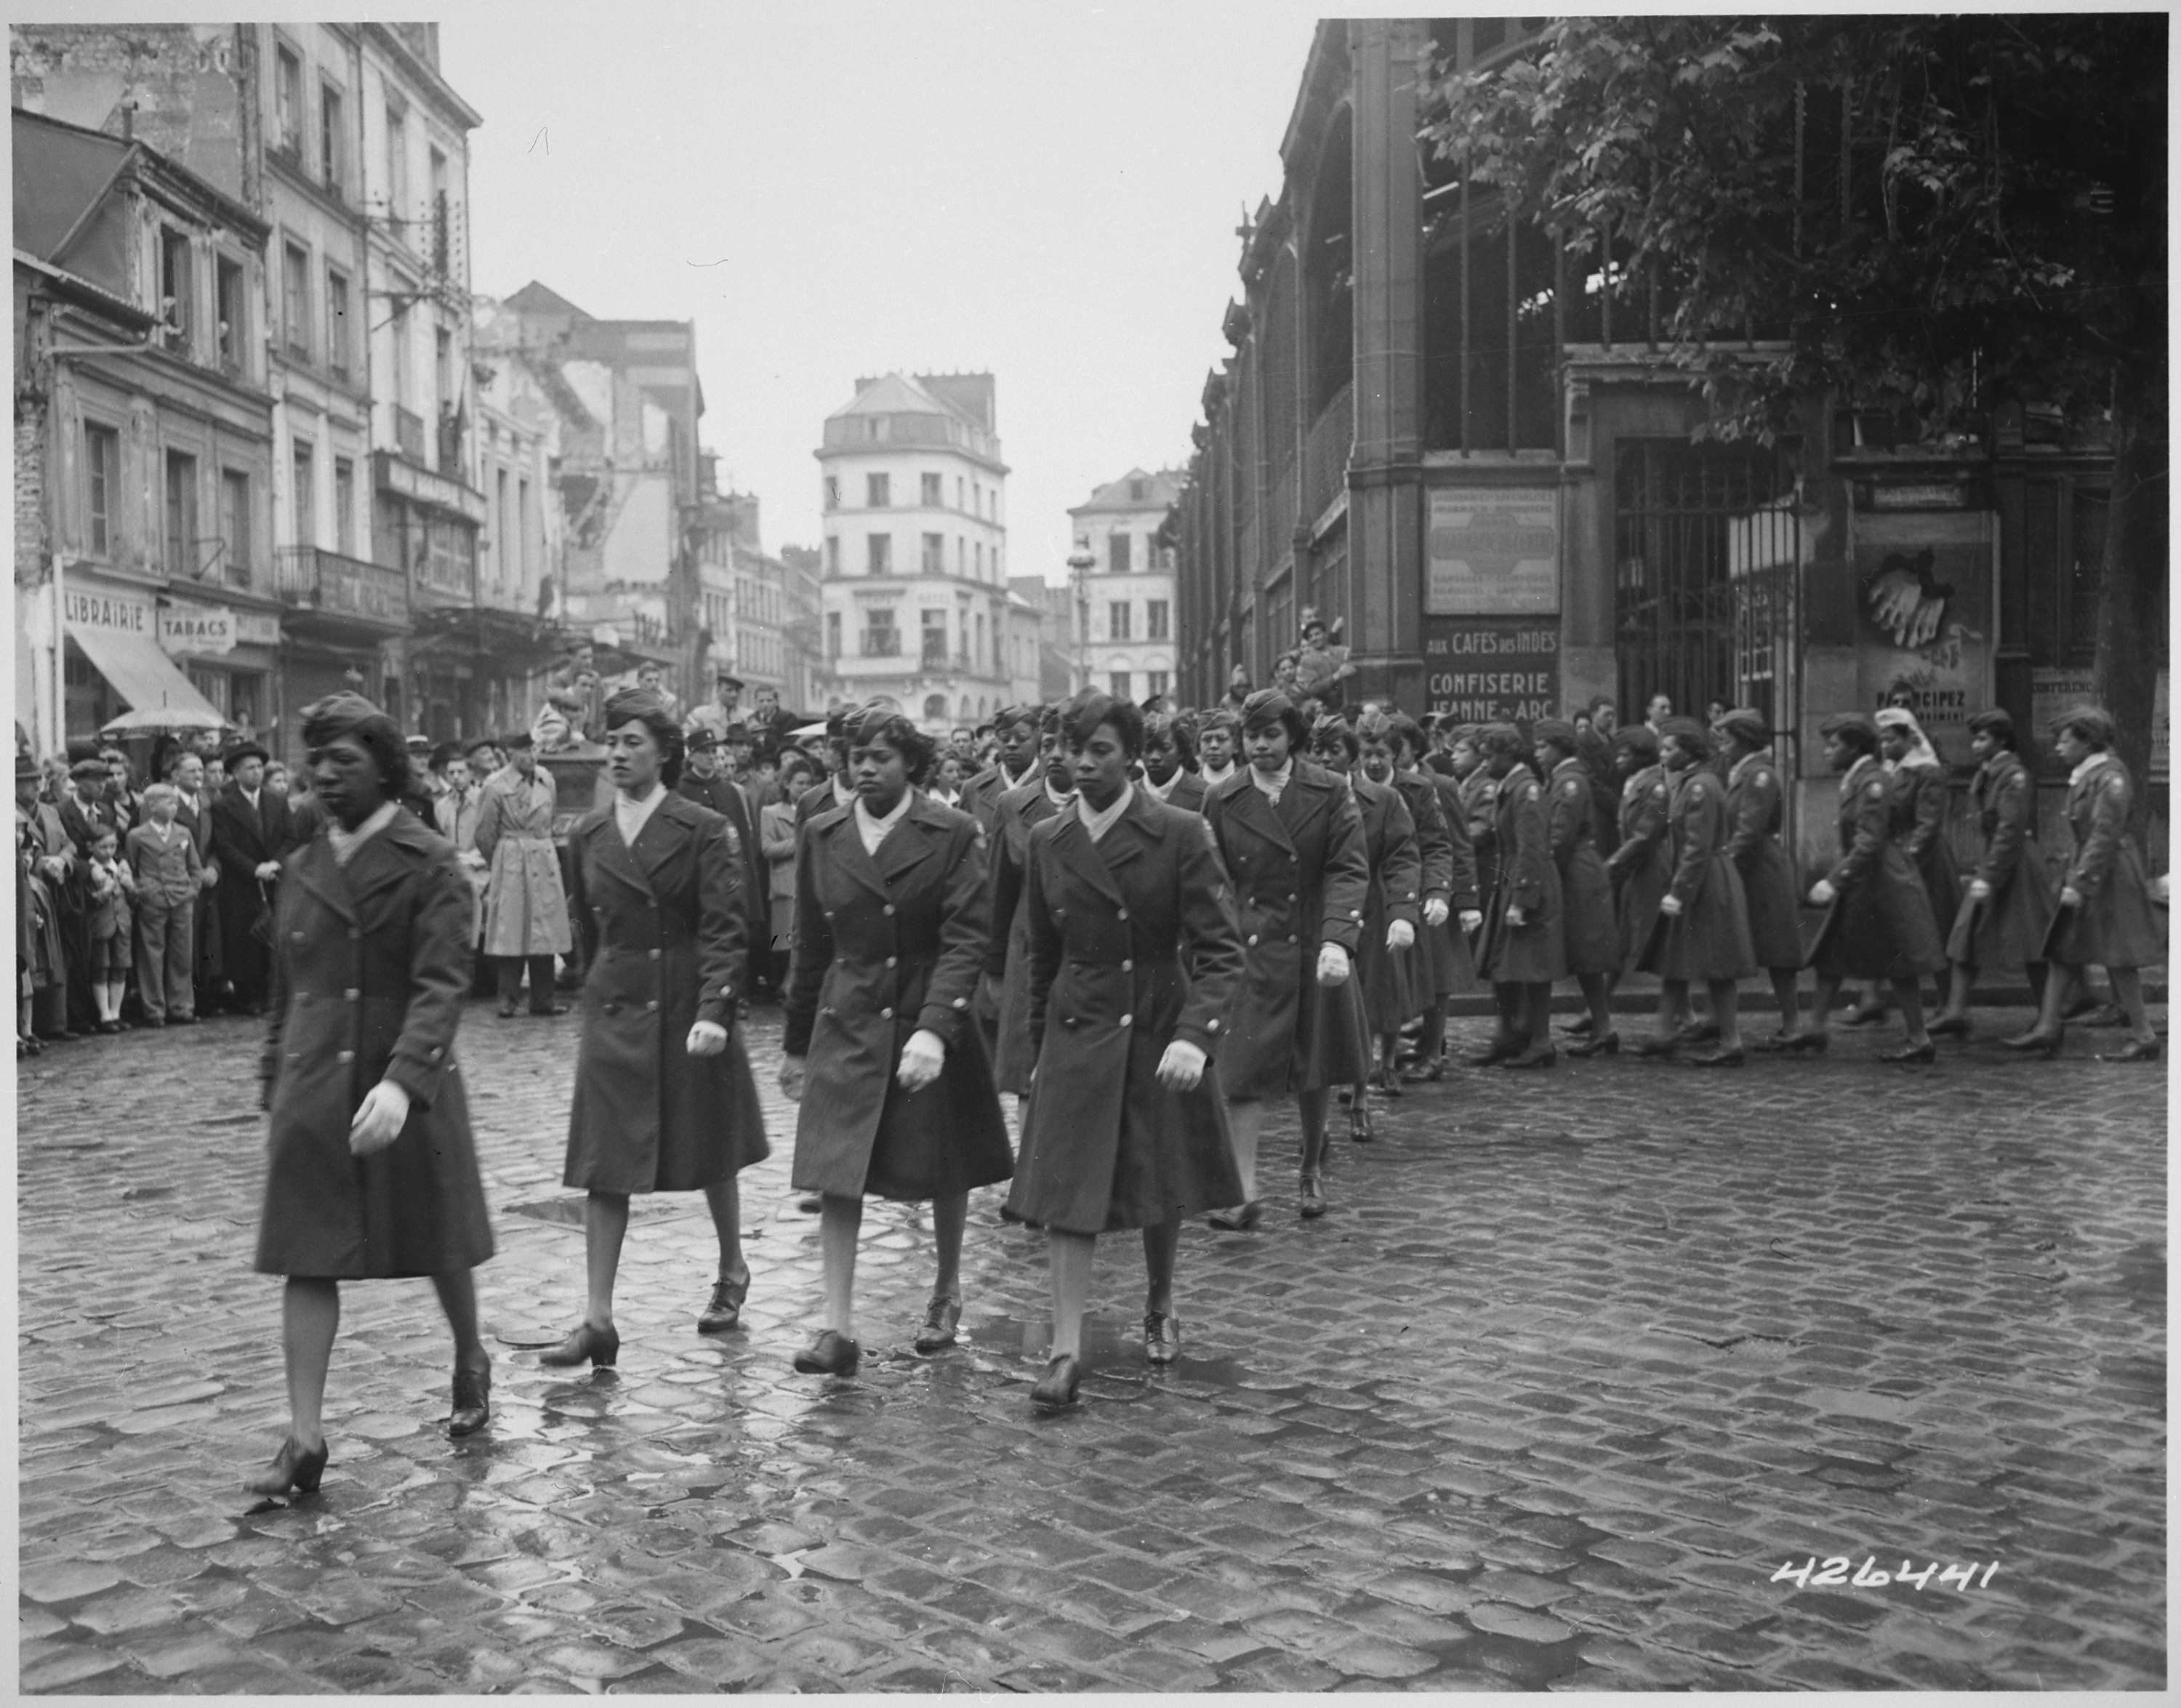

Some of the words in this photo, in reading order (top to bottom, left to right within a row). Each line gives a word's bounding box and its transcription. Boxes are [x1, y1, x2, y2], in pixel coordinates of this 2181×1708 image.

[164, 620, 227, 637] TABACS
[1517, 631, 1557, 653] INDES
[1430, 672, 1549, 695] CONFISERIE
